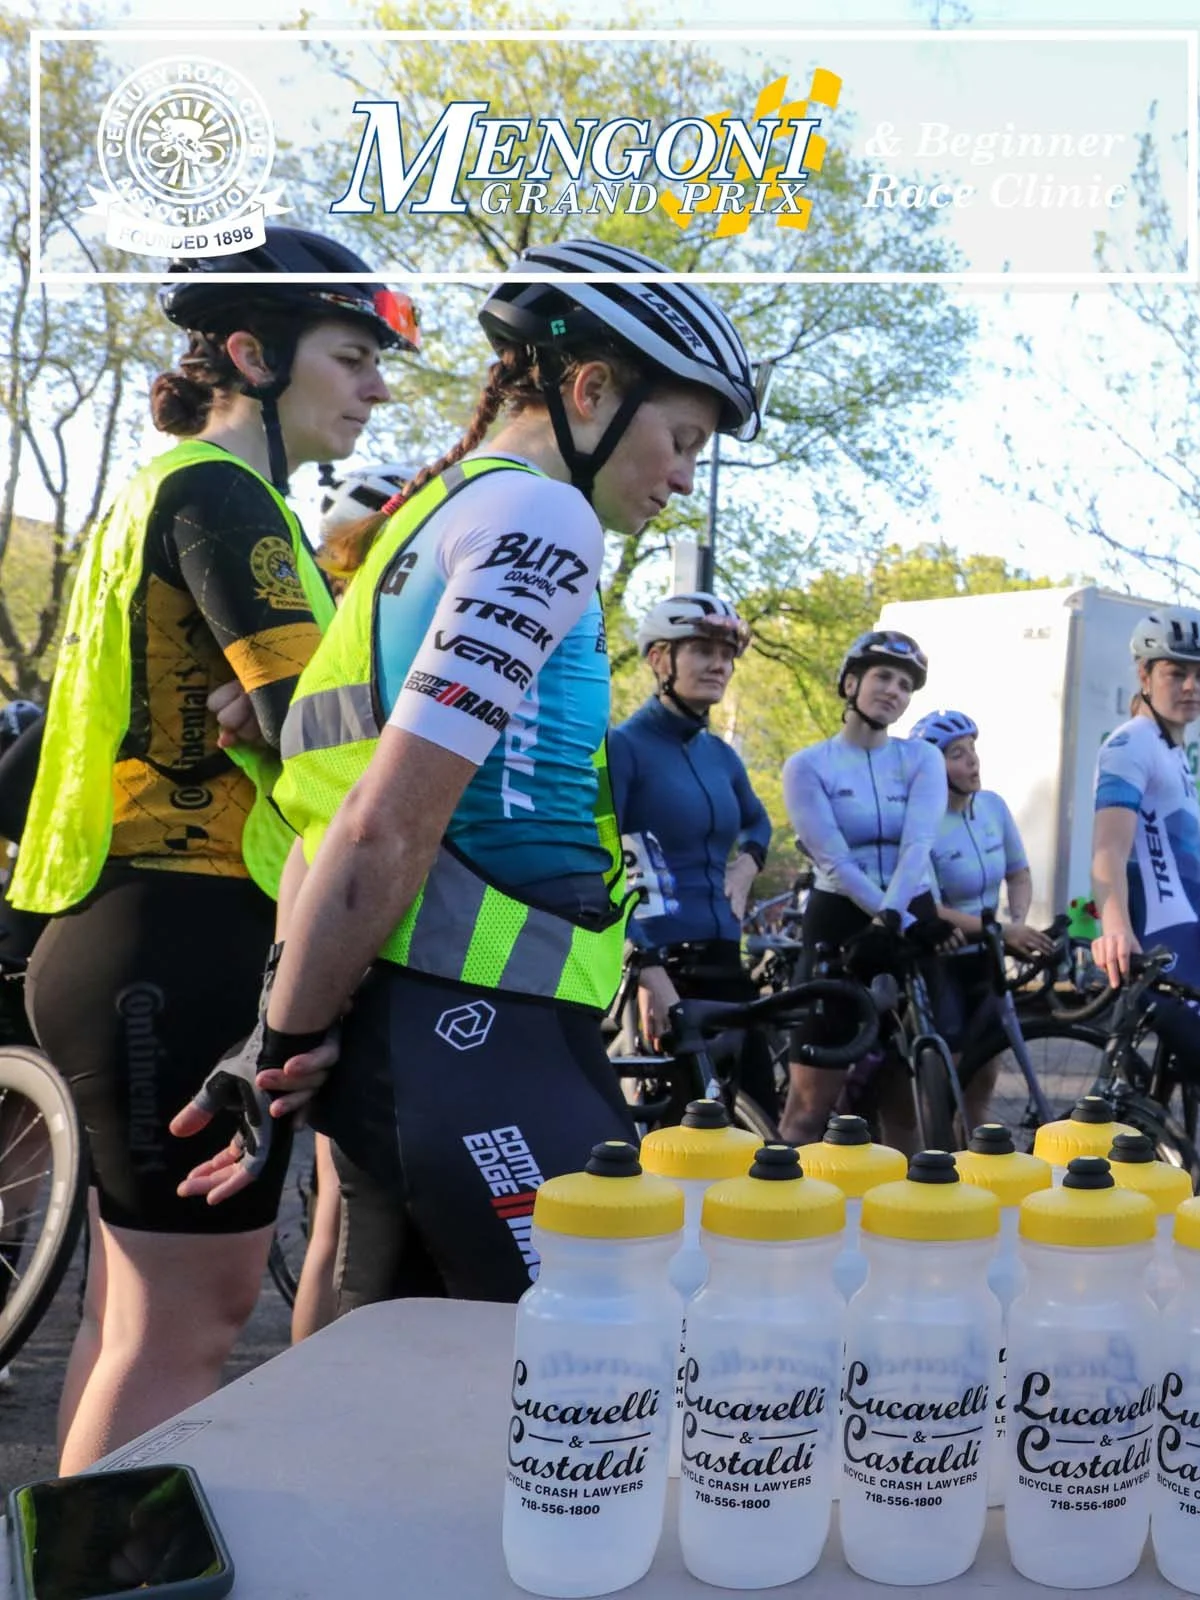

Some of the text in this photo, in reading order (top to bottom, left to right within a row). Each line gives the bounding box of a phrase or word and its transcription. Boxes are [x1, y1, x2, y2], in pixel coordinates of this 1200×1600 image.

[639, 292, 702, 350] LAZER
[471, 532, 588, 595] BLITZ
[454, 597, 554, 652] TREK
[1140, 808, 1174, 903] TREK
[462, 1132, 520, 1197] EDGE
[491, 1125, 546, 1189] COMP
[512, 1360, 660, 1425] Lucarelli
[684, 1357, 826, 1422] Lucarelli
[845, 1360, 989, 1421] Lucarelli
[1013, 1372, 1156, 1426] Lucarelli
[507, 1415, 649, 1481] Castaldi
[568, 1435, 584, 1448] &
[682, 1411, 816, 1477] Castaldi
[739, 1431, 754, 1444] &
[844, 1414, 981, 1474] Castaldi
[912, 1430, 927, 1443] &
[1017, 1425, 1152, 1479] Castaldi
[1100, 1434, 1113, 1447] &
[521, 1497, 600, 1515] 718-556-1800
[535, 1484, 578, 1498] CRASH
[583, 1480, 644, 1498] LAWYERS
[695, 1490, 770, 1509] 718-556-1800
[708, 1478, 749, 1492] CRASH
[754, 1475, 812, 1492] LAWYERS
[865, 1491, 942, 1507] 718-556-1800
[880, 1478, 922, 1490] CRASH
[927, 1472, 977, 1490] LAWYERS
[1018, 1475, 1062, 1494] BICYCLE
[1067, 1482, 1109, 1494] CRASH
[1050, 1497, 1126, 1511] 718-556-1800
